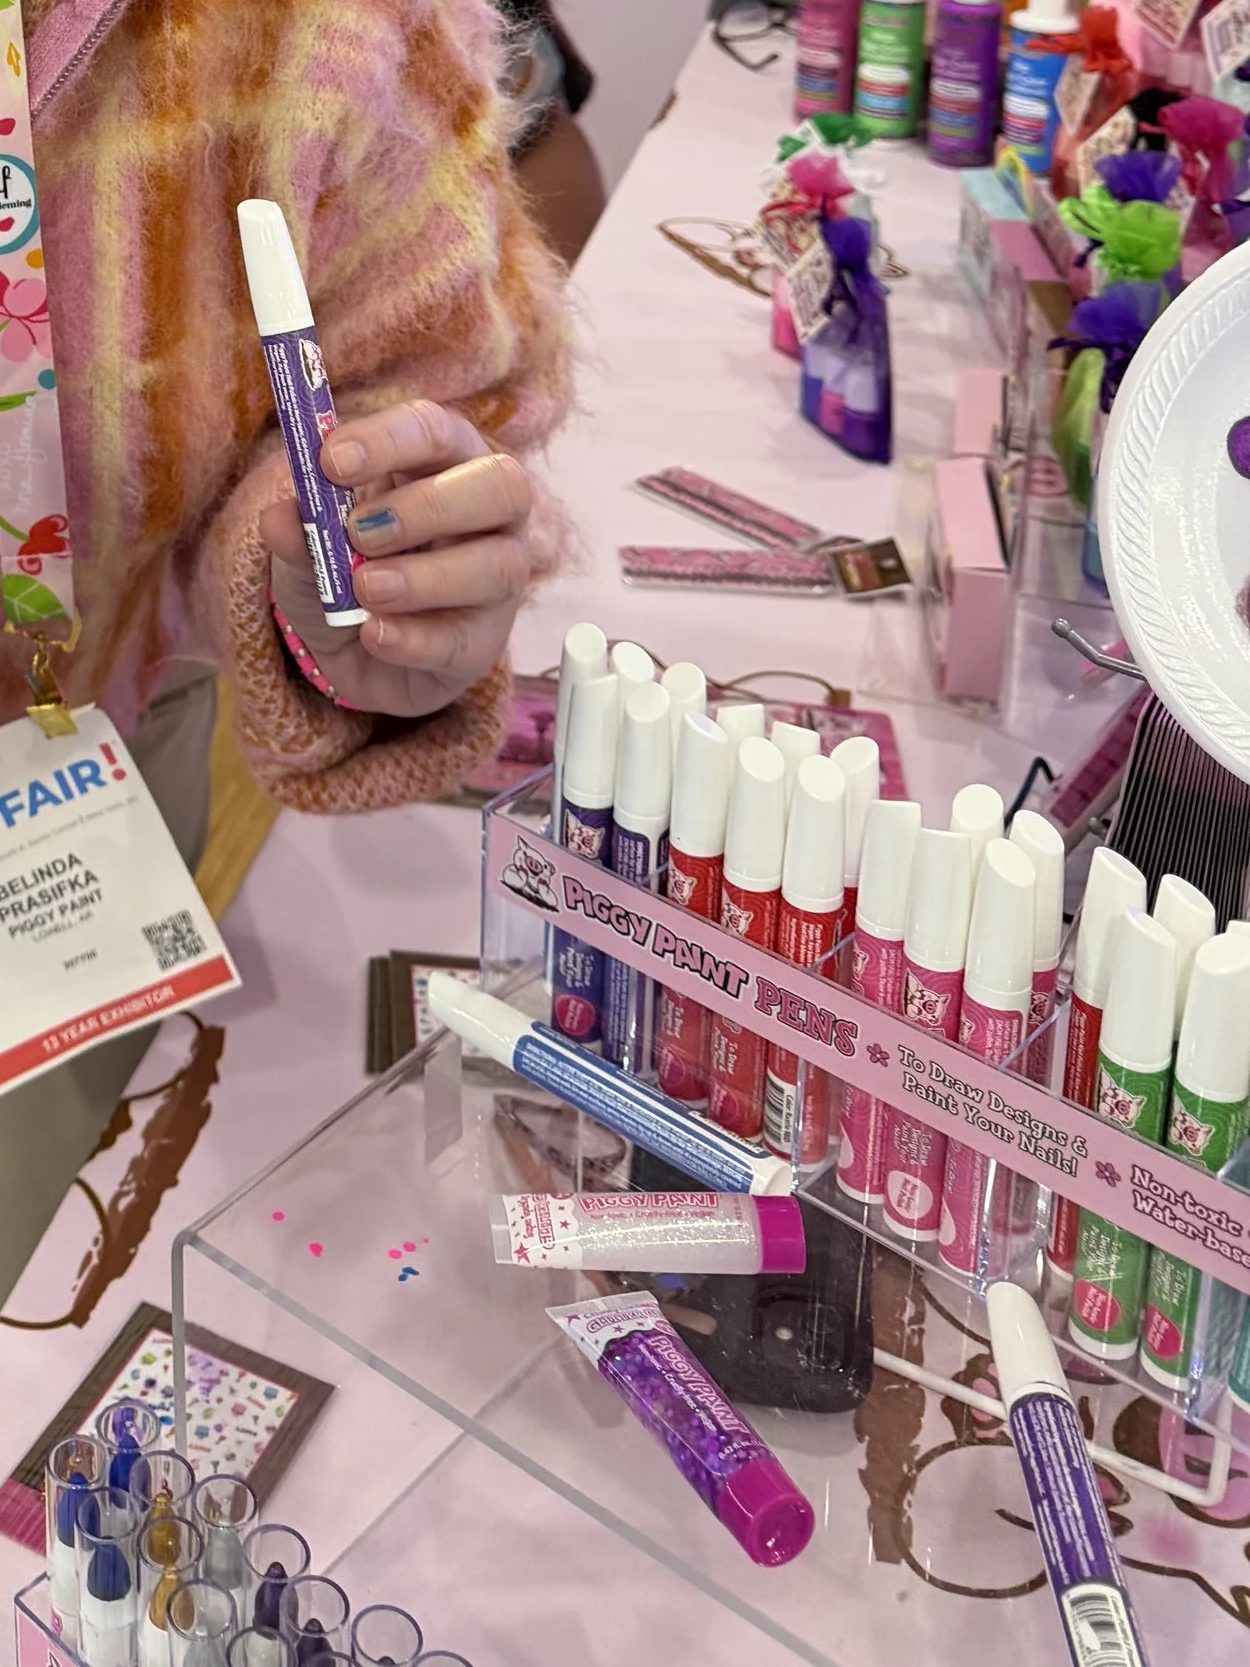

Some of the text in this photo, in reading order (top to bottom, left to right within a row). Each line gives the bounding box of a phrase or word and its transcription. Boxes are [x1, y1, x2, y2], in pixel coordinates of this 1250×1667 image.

[8, 887, 103, 939] PIGGY PAINT
[562, 875, 652, 947] PIGGY
[651, 923, 750, 999] PAINT
[753, 974, 859, 1058] PENS
[61, 1015, 98, 1044] YEAR
[99, 983, 176, 1031] EXHIBITOR
[898, 1044, 1088, 1160] To Draw Designs &
[902, 1071, 1079, 1178] Paint Your Nails!
[579, 1192, 720, 1212] PIGGY PAINT
[1132, 1166, 1244, 1238] Non-toxic
[648, 1334, 751, 1435] PIGGY PAINT
